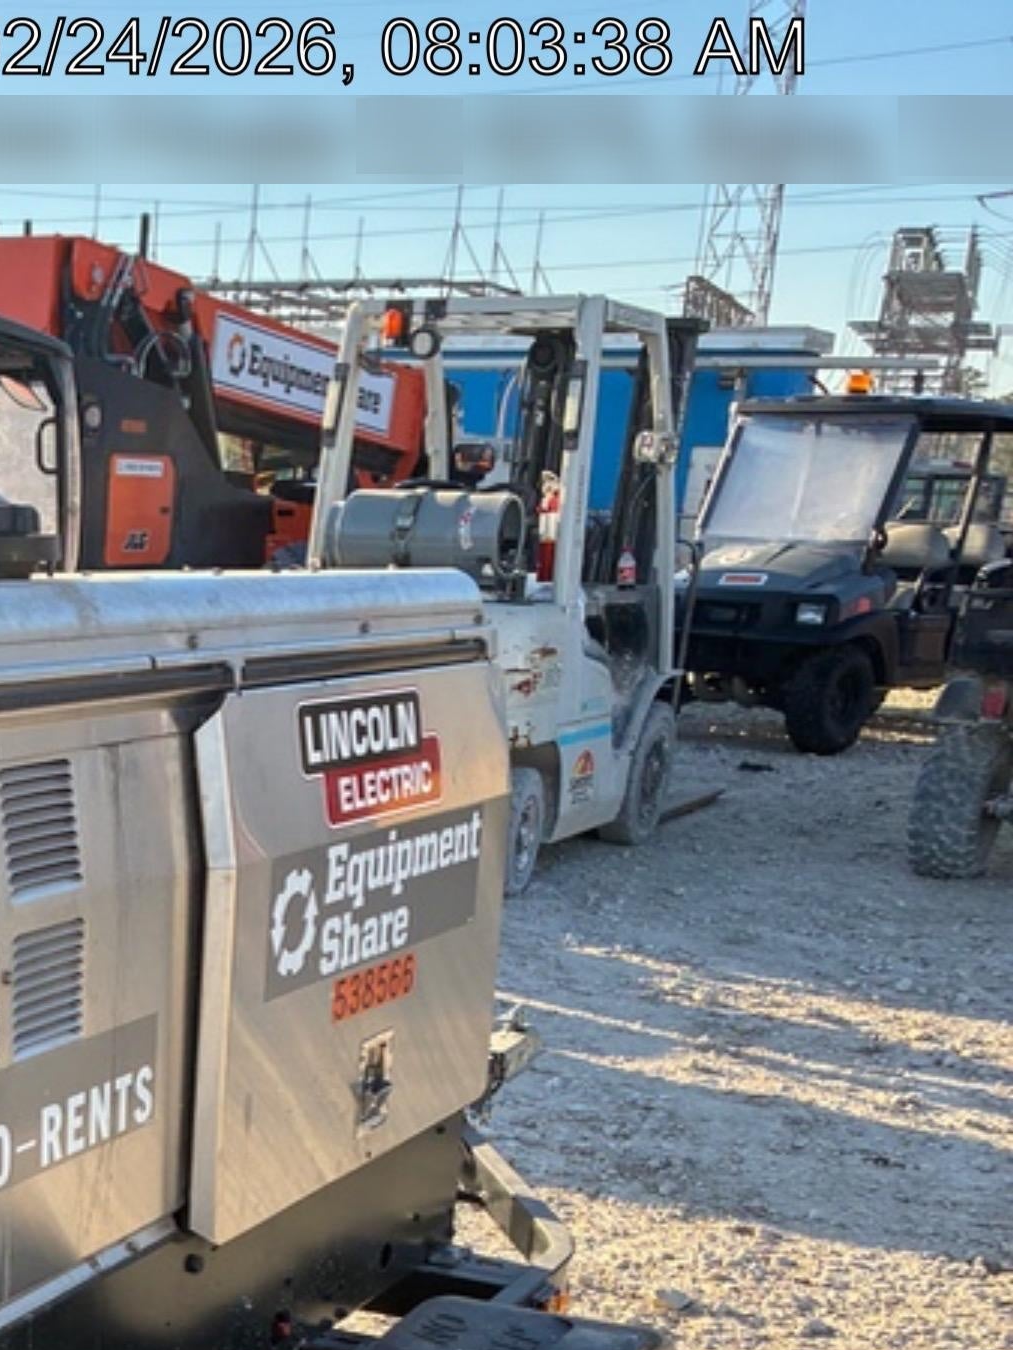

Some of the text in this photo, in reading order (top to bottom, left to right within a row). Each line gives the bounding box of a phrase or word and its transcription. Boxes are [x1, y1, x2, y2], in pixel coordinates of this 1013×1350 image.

[303, 701, 418, 766] LINCOLN
[339, 761, 433, 814] ELECTRIC
[324, 809, 483, 908] Equipment
[318, 904, 410, 977] Share
